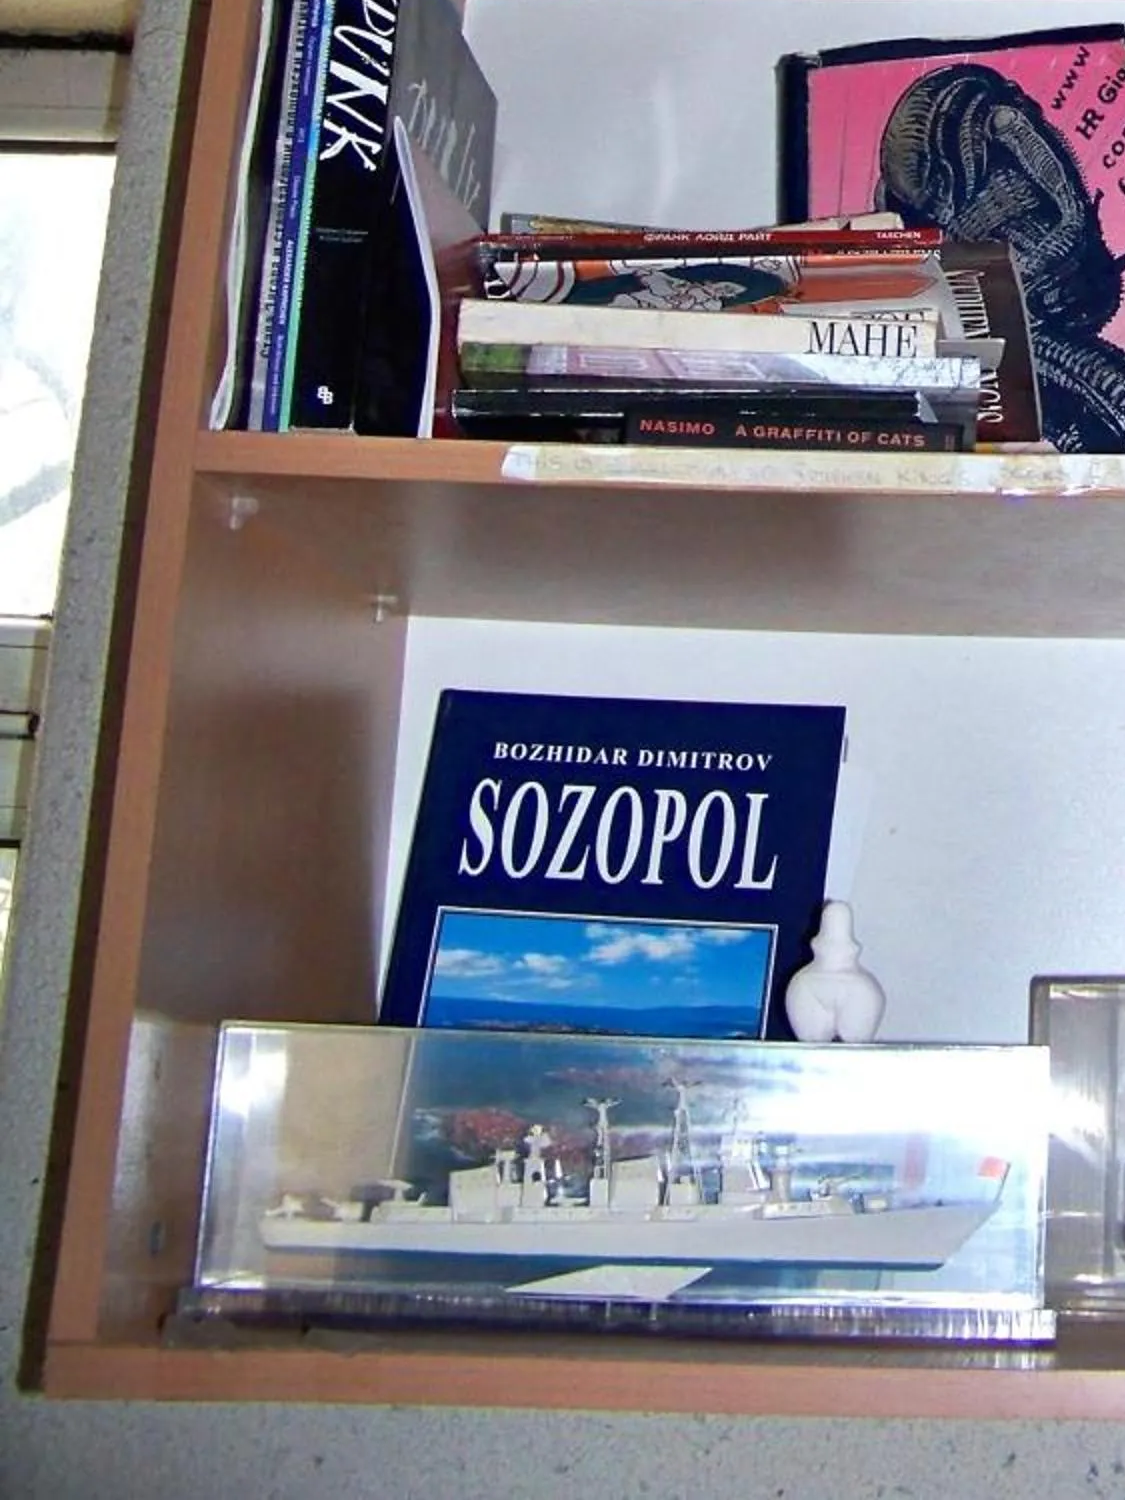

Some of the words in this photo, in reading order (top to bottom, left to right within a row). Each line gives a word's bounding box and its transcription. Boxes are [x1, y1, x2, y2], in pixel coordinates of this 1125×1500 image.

[1049, 46, 1090, 110] www
[1074, 105, 1106, 141] HR
[643, 232, 690, 242] ФРАНК
[696, 232, 734, 242] ЛОЙД
[739, 232, 773, 242] РАЙТ
[876, 231, 921, 240] TASCHEN
[639, 419, 716, 436] NASIMO
[734, 422, 748, 437] A
[751, 423, 842, 442] GRAFFITI
[845, 428, 873, 443] OF
[877, 430, 926, 447] CATS
[493, 741, 629, 767] BOZHIDAR
[637, 748, 774, 773] DIMITROV
[457, 777, 778, 890] SOZOPOL
